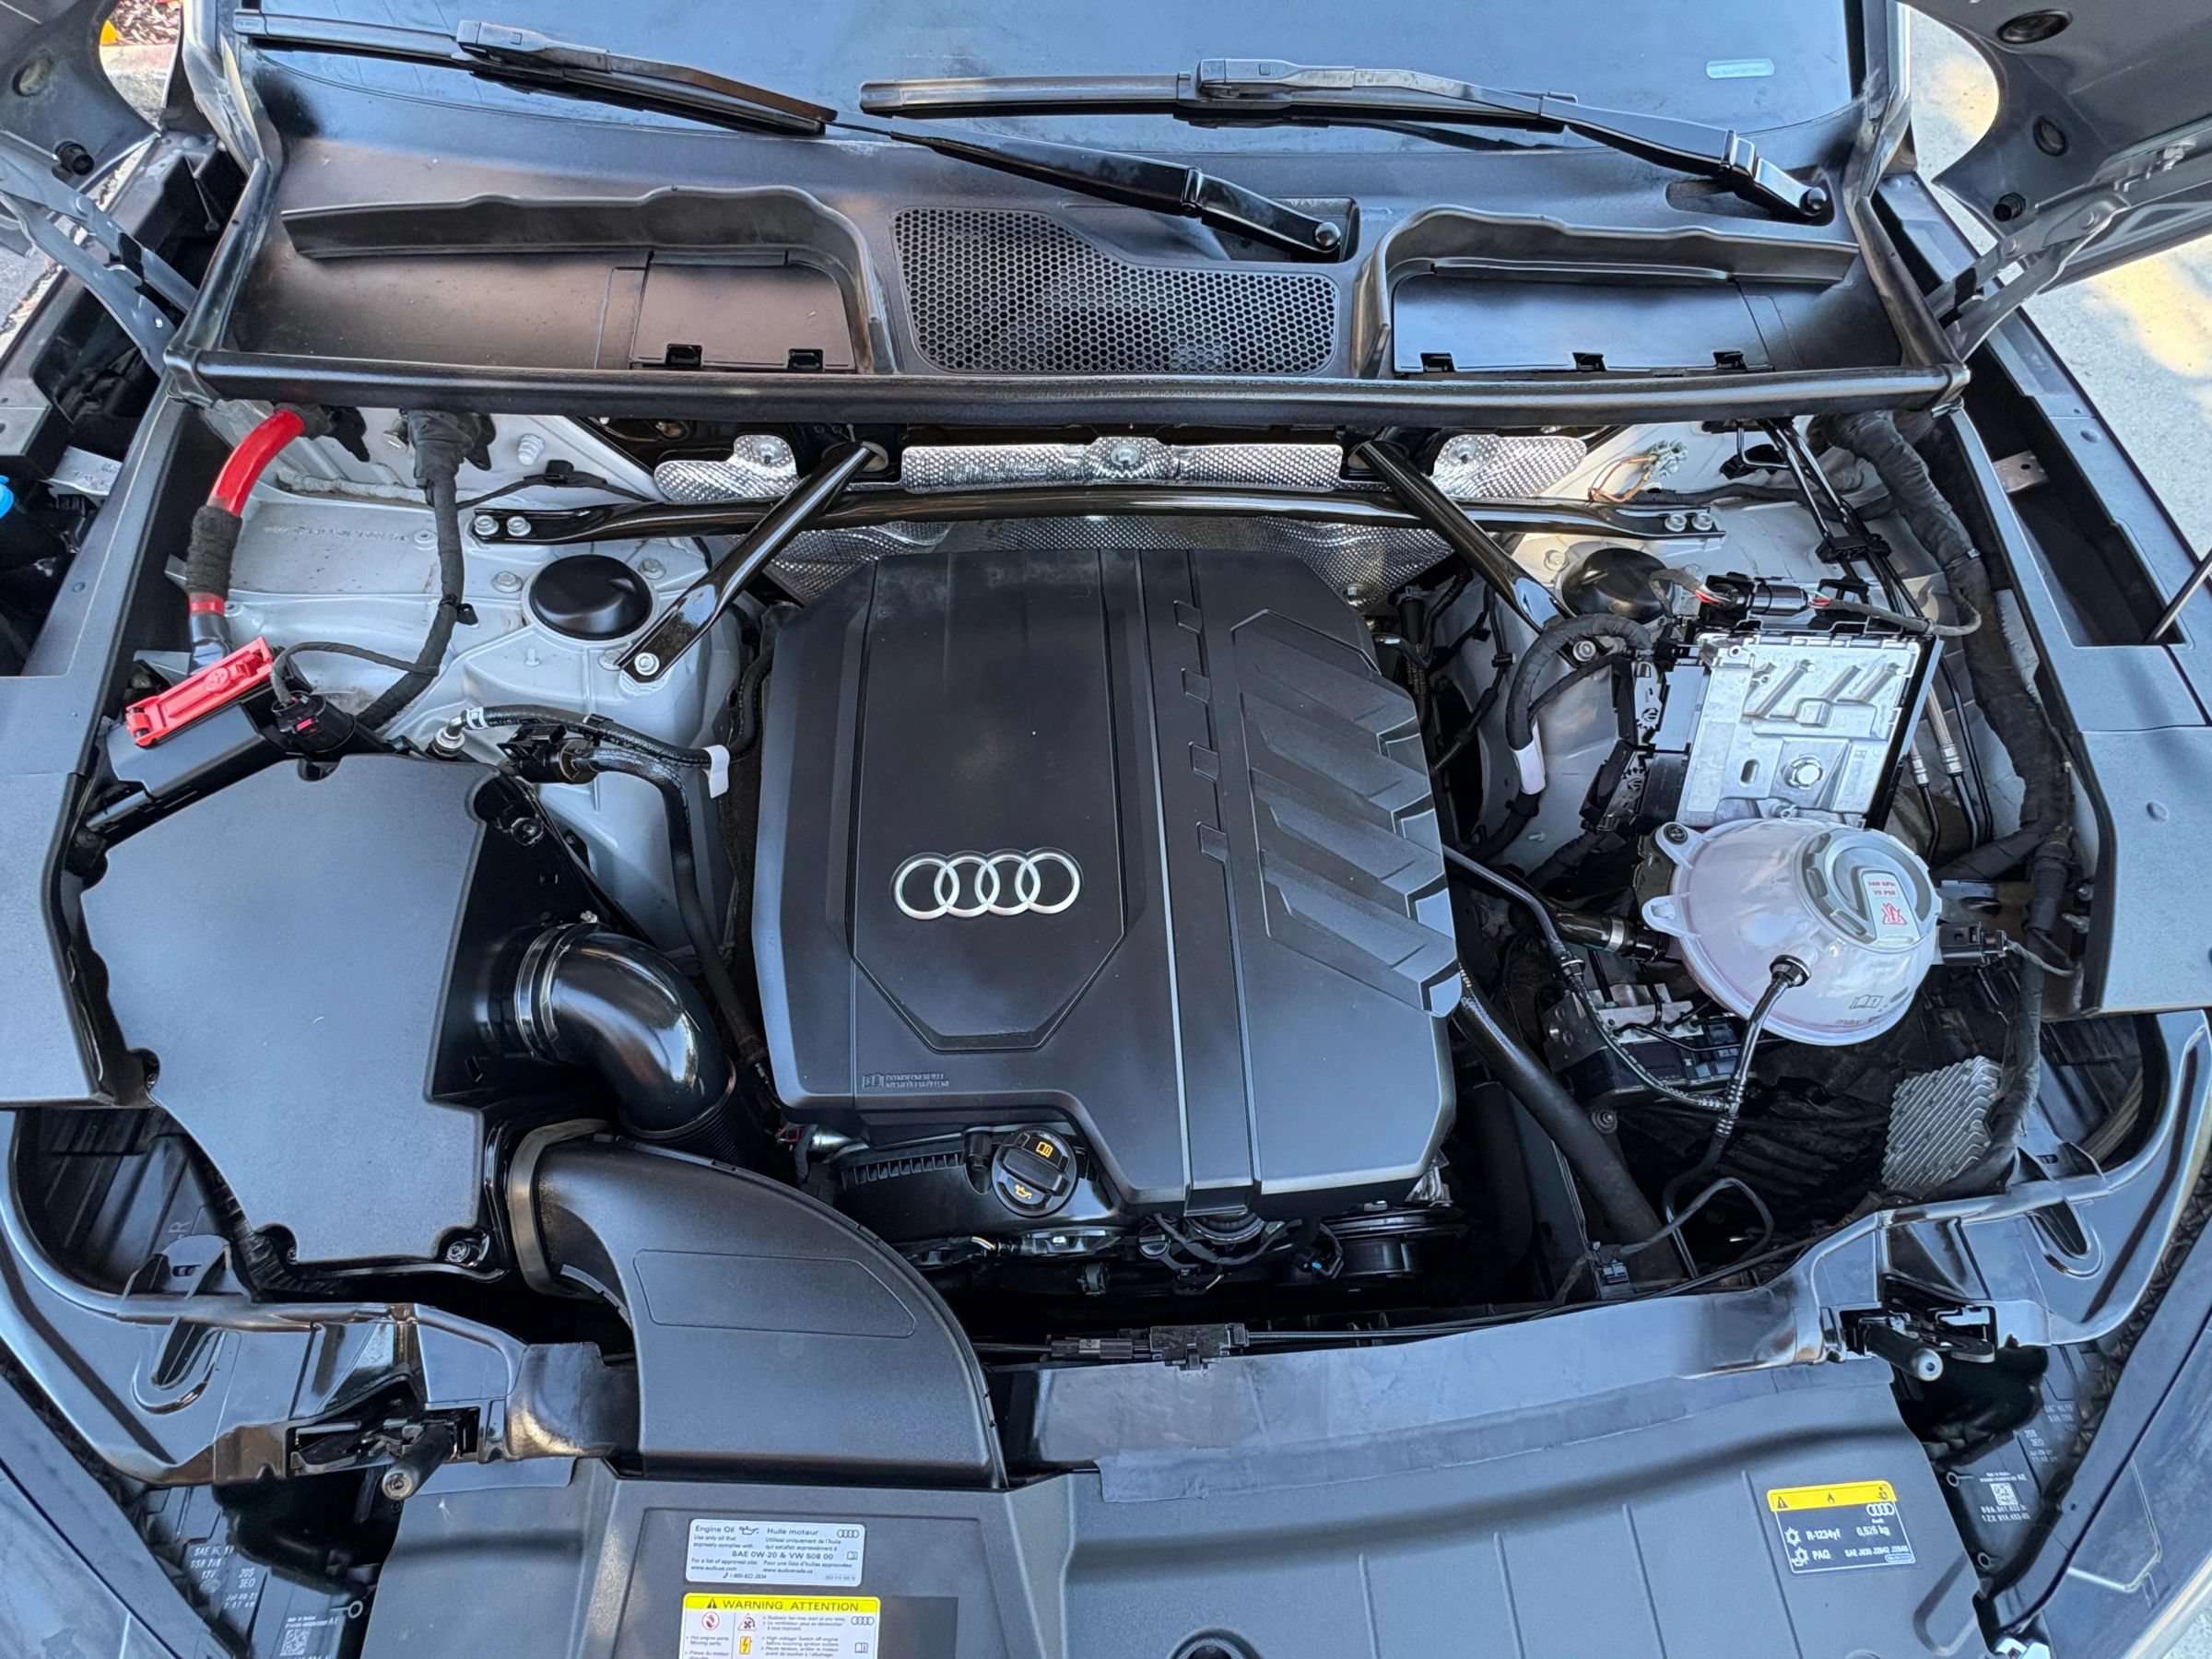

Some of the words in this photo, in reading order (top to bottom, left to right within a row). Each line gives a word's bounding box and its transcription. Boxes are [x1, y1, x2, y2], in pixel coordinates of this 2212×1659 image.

[695, 1525, 722, 1534] Engine
[1806, 1527, 1841, 1541] R-1234yf
[1877, 1524, 1891, 1536] kg
[1812, 1549, 1831, 1560] PAG
[723, 1600, 783, 1610] WARNING
[790, 1601, 859, 1611] ATTENTION
